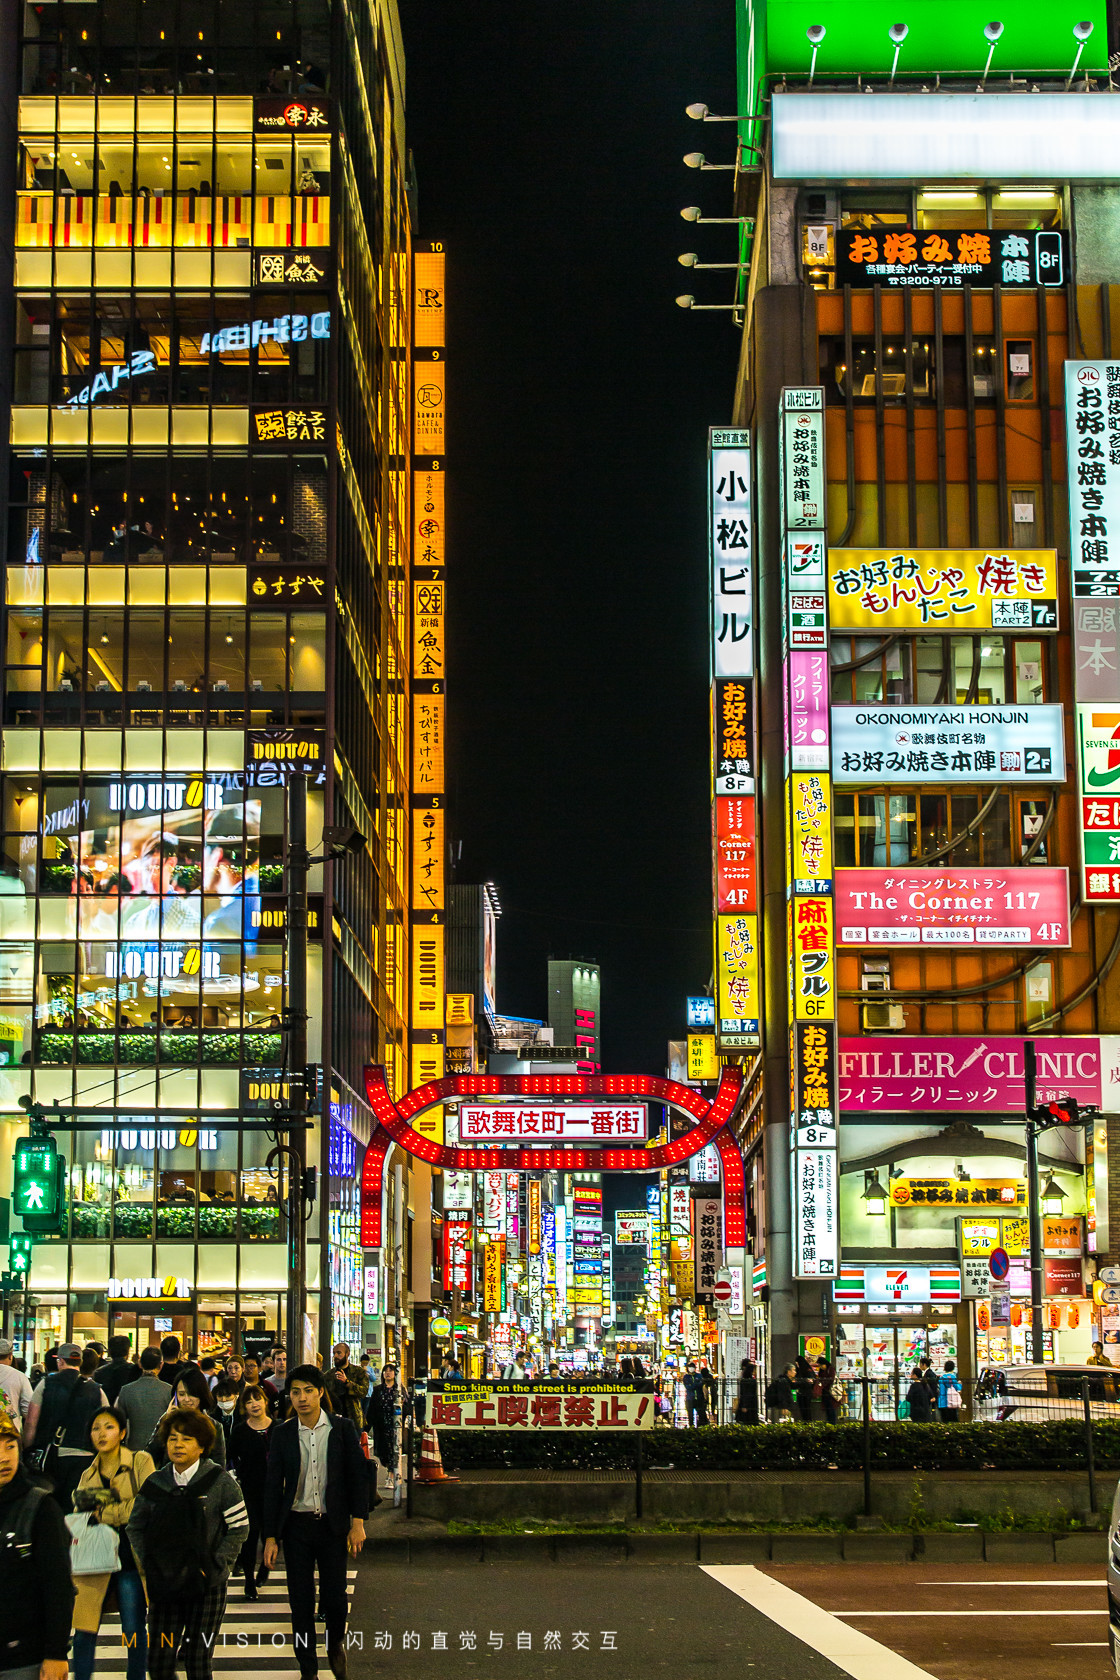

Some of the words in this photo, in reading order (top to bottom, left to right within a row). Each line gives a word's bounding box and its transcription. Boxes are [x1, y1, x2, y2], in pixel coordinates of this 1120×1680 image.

[431, 243, 442, 252] 10
[811, 242, 825, 251] 8F
[849, 233, 991, 264] お好み焼
[1001, 234, 1030, 283] 本陣
[1040, 251, 1058, 268] 8F
[285, 263, 324, 282] 魚金
[899, 276, 962, 285] 3200-9715
[432, 351, 440, 360] 9
[787, 392, 820, 407] 小松ビル
[285, 411, 326, 426] 餃子
[286, 425, 325, 440] BAR
[713, 433, 749, 444] 全館直営
[432, 461, 440, 470] 8
[793, 428, 810, 502] お好み焼本陣
[1075, 387, 1109, 564] お好み焼き本陣
[795, 518, 818, 527] 2F
[716, 470, 750, 643] 小松ビル
[432, 570, 440, 580] 7
[832, 555, 919, 595] お好み
[977, 555, 1045, 594] 焼き
[861, 568, 963, 613] もんじゃ
[1090, 586, 1118, 595] 2F
[793, 596, 823, 608] たばこ
[917, 588, 976, 622] たこ
[994, 602, 1029, 616] 本陣
[420, 617, 439, 628] 新橋
[801, 613, 816, 626] 酒
[1032, 605, 1056, 624] 7F
[418, 631, 442, 674] 魚金
[432, 684, 440, 693] 6
[811, 656, 823, 711] フィラー
[793, 674, 808, 744] クリニック
[722, 682, 747, 759] お好み焼
[855, 713, 964, 725] OKONOMIYAKI
[969, 712, 1029, 724] HONJIN
[911, 733, 986, 745] 歌舞伎町名物
[1086, 741, 1109, 749] SEVEN
[253, 740, 319, 759] DOUTOR
[720, 759, 750, 774] 本陣
[841, 751, 997, 772] お好み焼き本陣
[1025, 751, 1051, 771] 2F
[725, 777, 746, 790] 8F
[109, 780, 223, 811] DOUTOR
[432, 798, 439, 807] 5
[809, 777, 828, 812] お好み
[799, 782, 821, 828] もんじゃ
[796, 809, 811, 832] たこ
[719, 840, 752, 848] Corner
[725, 851, 746, 861] 117
[801, 835, 823, 875] 焼き
[420, 831, 438, 908] すずや
[815, 880, 830, 892] 7F
[884, 879, 1007, 889] ダイニングレストラン
[725, 889, 749, 905] 4F
[849, 891, 898, 910] The
[908, 891, 993, 910] Corner
[1004, 891, 1040, 910] 117
[431, 914, 439, 923] 4
[798, 899, 828, 951] 麻雀
[736, 919, 754, 954] お好み
[845, 930, 863, 939] 個室
[872, 930, 917, 939] 宴会ホール
[926, 930, 970, 939] 最大100名
[979, 930, 1027, 939] 貸切PARTY
[1036, 923, 1062, 941] 4F
[726, 923, 748, 970] もんじゃ
[105, 948, 221, 979] DOUTOR
[723, 951, 738, 974] たこ
[419, 940, 438, 1011] DOUTOR
[801, 952, 830, 997] ブル
[728, 975, 750, 1016] 焼き
[805, 1000, 825, 1015] 6F
[742, 1020, 755, 1031] 7F
[431, 1034, 439, 1044] 3
[803, 1025, 830, 1108] お好み焼
[838, 1052, 957, 1079] FILLER
[984, 1052, 1097, 1079] CLNIC
[839, 1087, 903, 1103] フィラー
[910, 1086, 998, 1103] クリニック
[448, 1103, 457, 1112] 3
[467, 1111, 640, 1135] 歌舞伎町一番街
[800, 1109, 833, 1125] 本陣
[806, 1129, 828, 1143] 8F
[448, 1211, 469, 1221] 焼肉
[802, 1164, 816, 1261] お好み焼き本陣
[820, 1260, 834, 1273] 2F
[108, 1276, 190, 1298] DOUTOR
[367, 1270, 375, 1313] 劇場通り
[886, 1271, 907, 1299] 7
[513, 1383, 530, 1392] the
[533, 1384, 565, 1393] street
[568, 1383, 577, 1392] is
[580, 1383, 636, 1394] prohibited.
